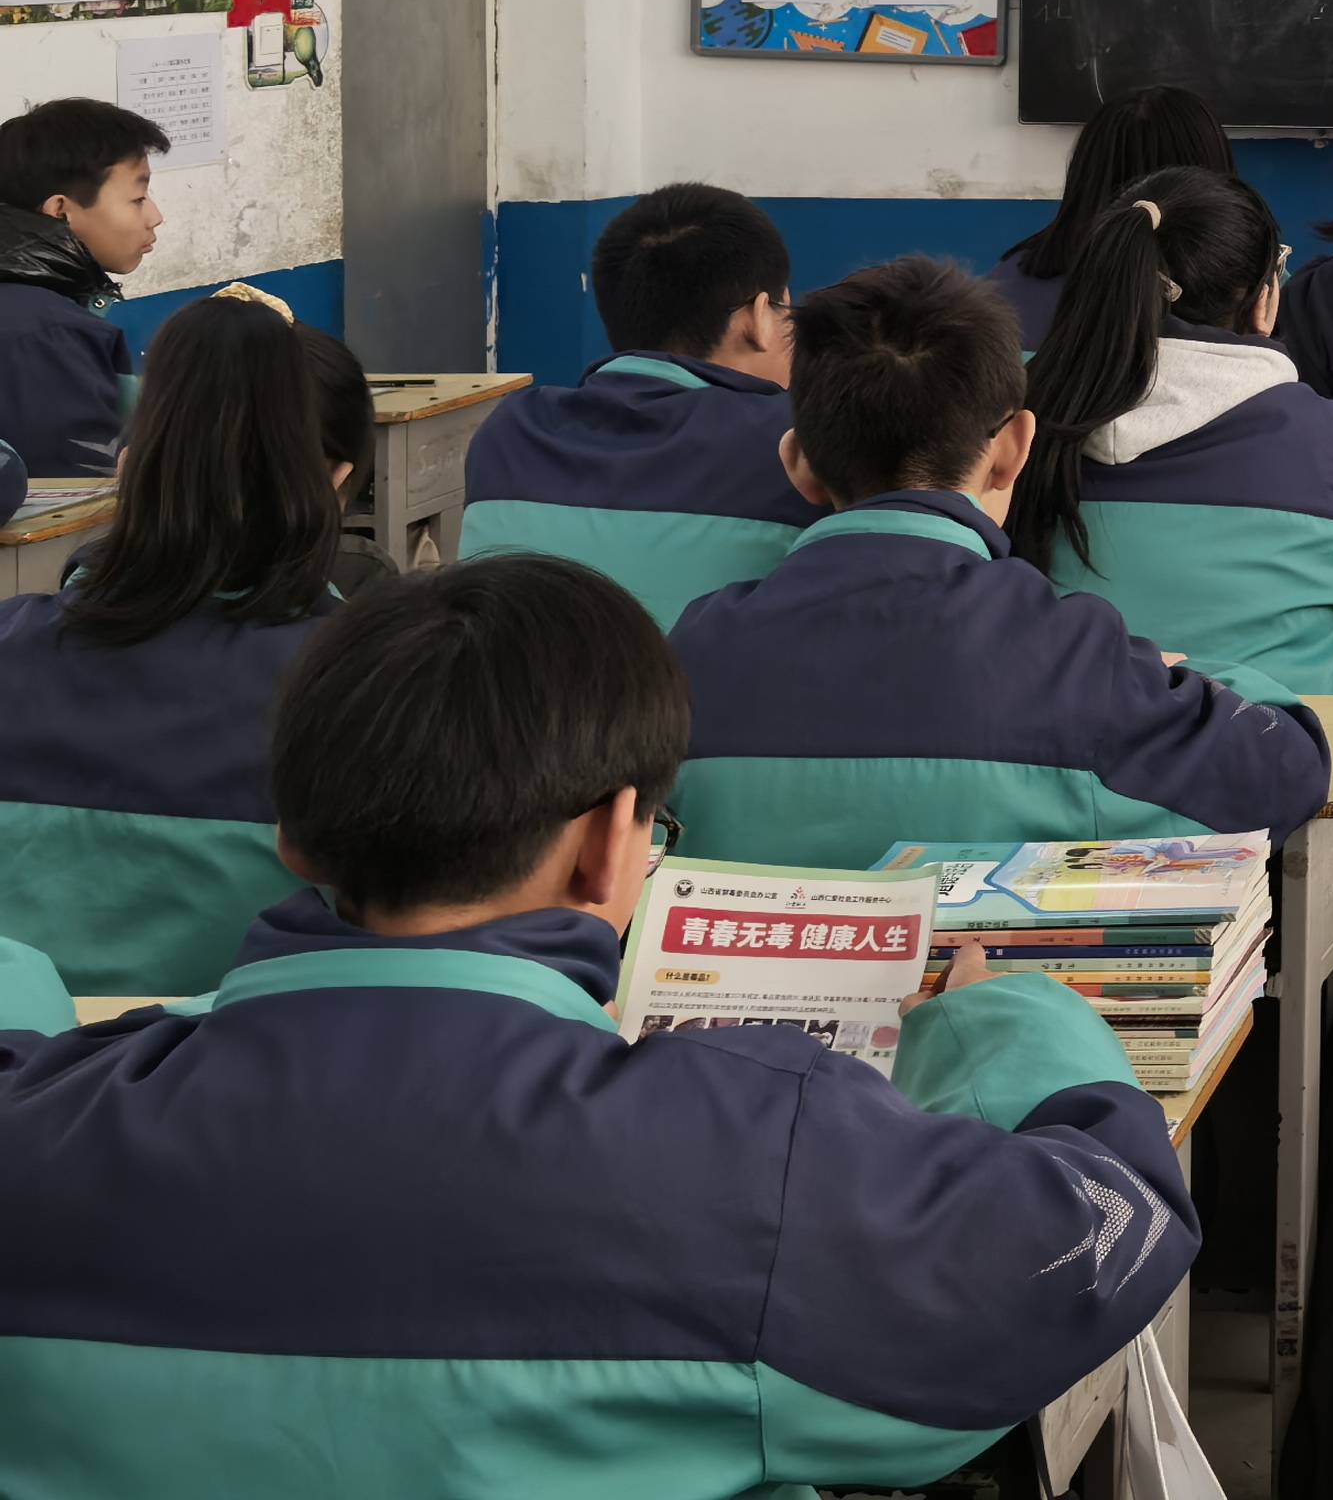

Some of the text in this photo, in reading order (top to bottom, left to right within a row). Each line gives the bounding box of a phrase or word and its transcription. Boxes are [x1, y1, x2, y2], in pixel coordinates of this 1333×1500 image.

[682, 917, 907, 953] 青春无毒 健康人生
